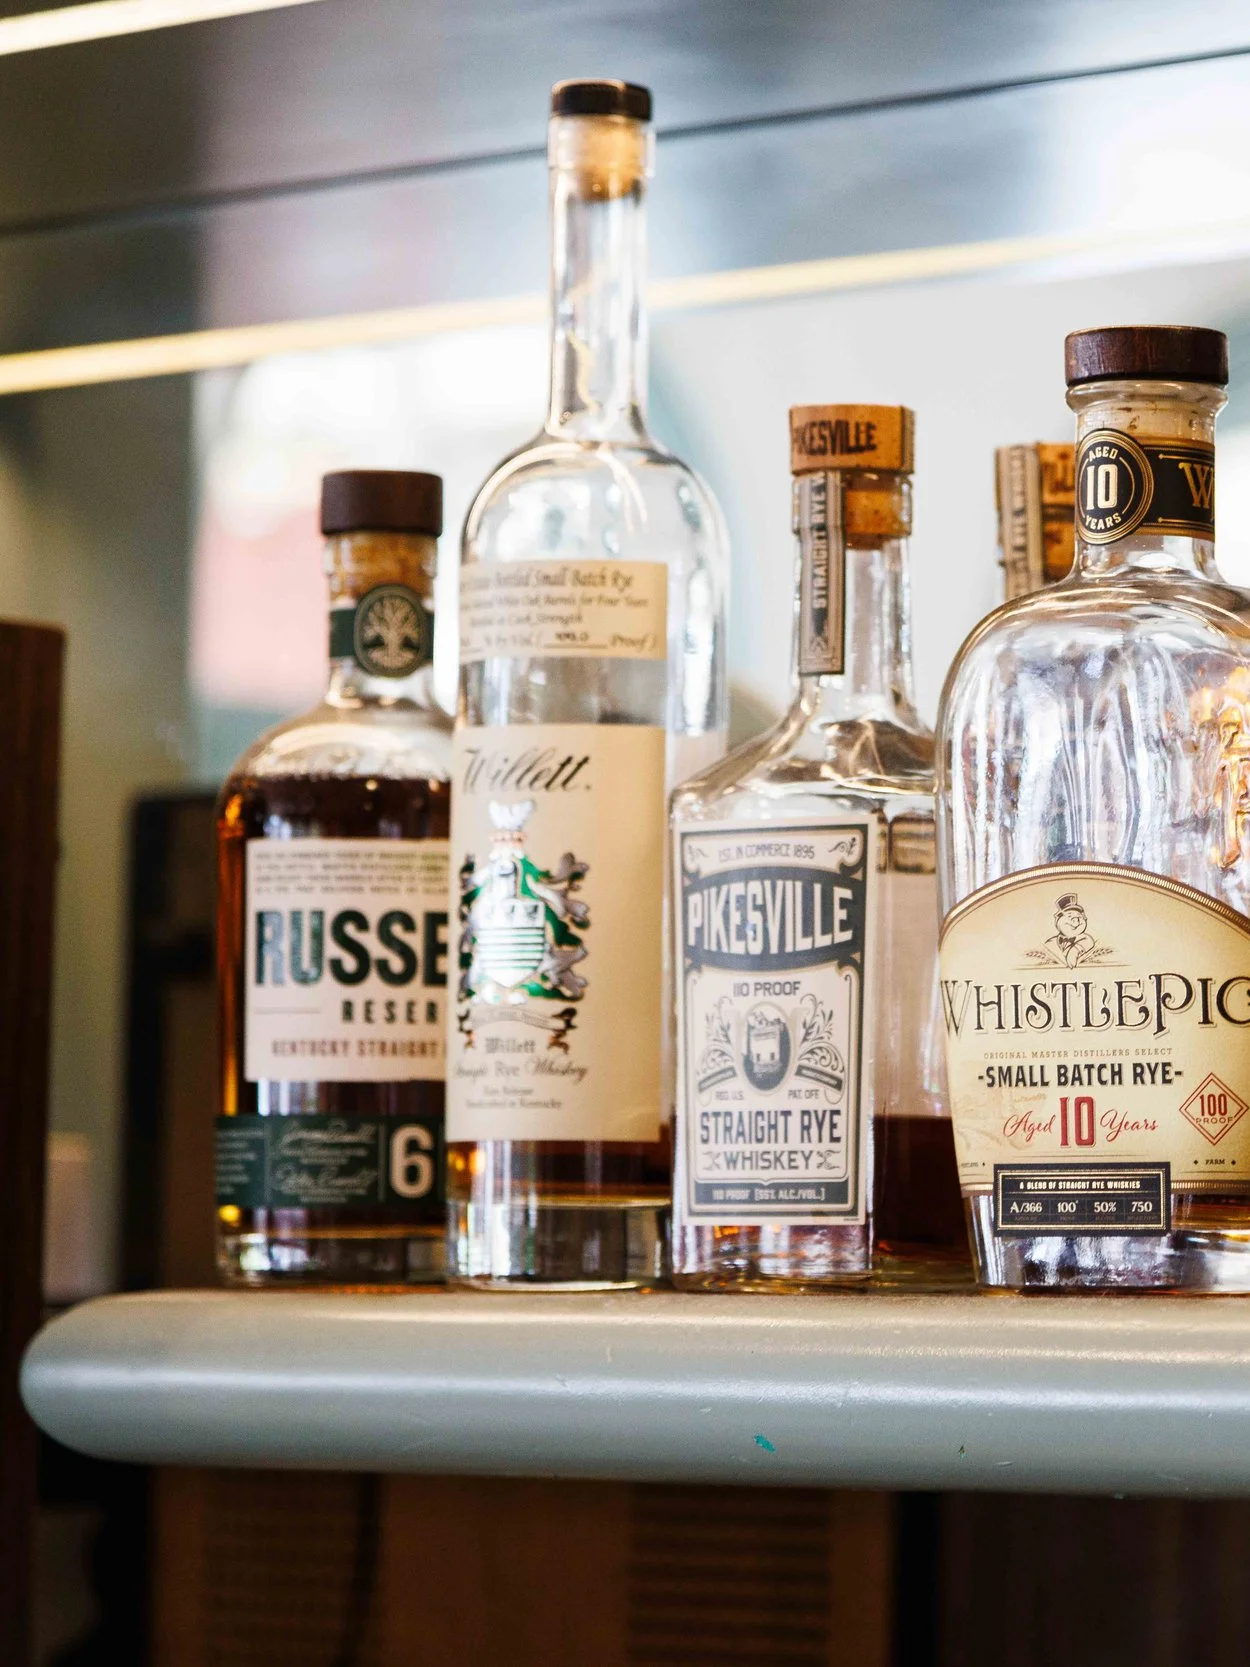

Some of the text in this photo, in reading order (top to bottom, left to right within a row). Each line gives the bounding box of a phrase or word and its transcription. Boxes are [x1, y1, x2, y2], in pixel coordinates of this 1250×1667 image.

[1087, 446, 1119, 463] AGED
[1086, 463, 1119, 511] 10
[1084, 512, 1122, 530] YEARS
[793, 843, 815, 860] 1895
[688, 879, 853, 955] PIKESVILLE
[753, 980, 802, 997] PROOF
[983, 1047, 1173, 1060] ORIGINAL MASTER DISTILLERS SELECT
[1056, 1062, 1123, 1088] BATCH
[1199, 1093, 1228, 1117] 100
[701, 1109, 842, 1145] STRAIGHT RYE
[1002, 1096, 1159, 1149] Aged 10 Years
[1195, 1116, 1235, 1126] PROOF
[389, 1123, 434, 1199] 6
[724, 1150, 815, 1171] WHISKEY
[1106, 1180, 1141, 1190] WHISKIES
[1009, 1201, 1043, 1213] A/366
[1093, 1201, 1117, 1213] 50%
[1131, 1201, 1153, 1213] 750
